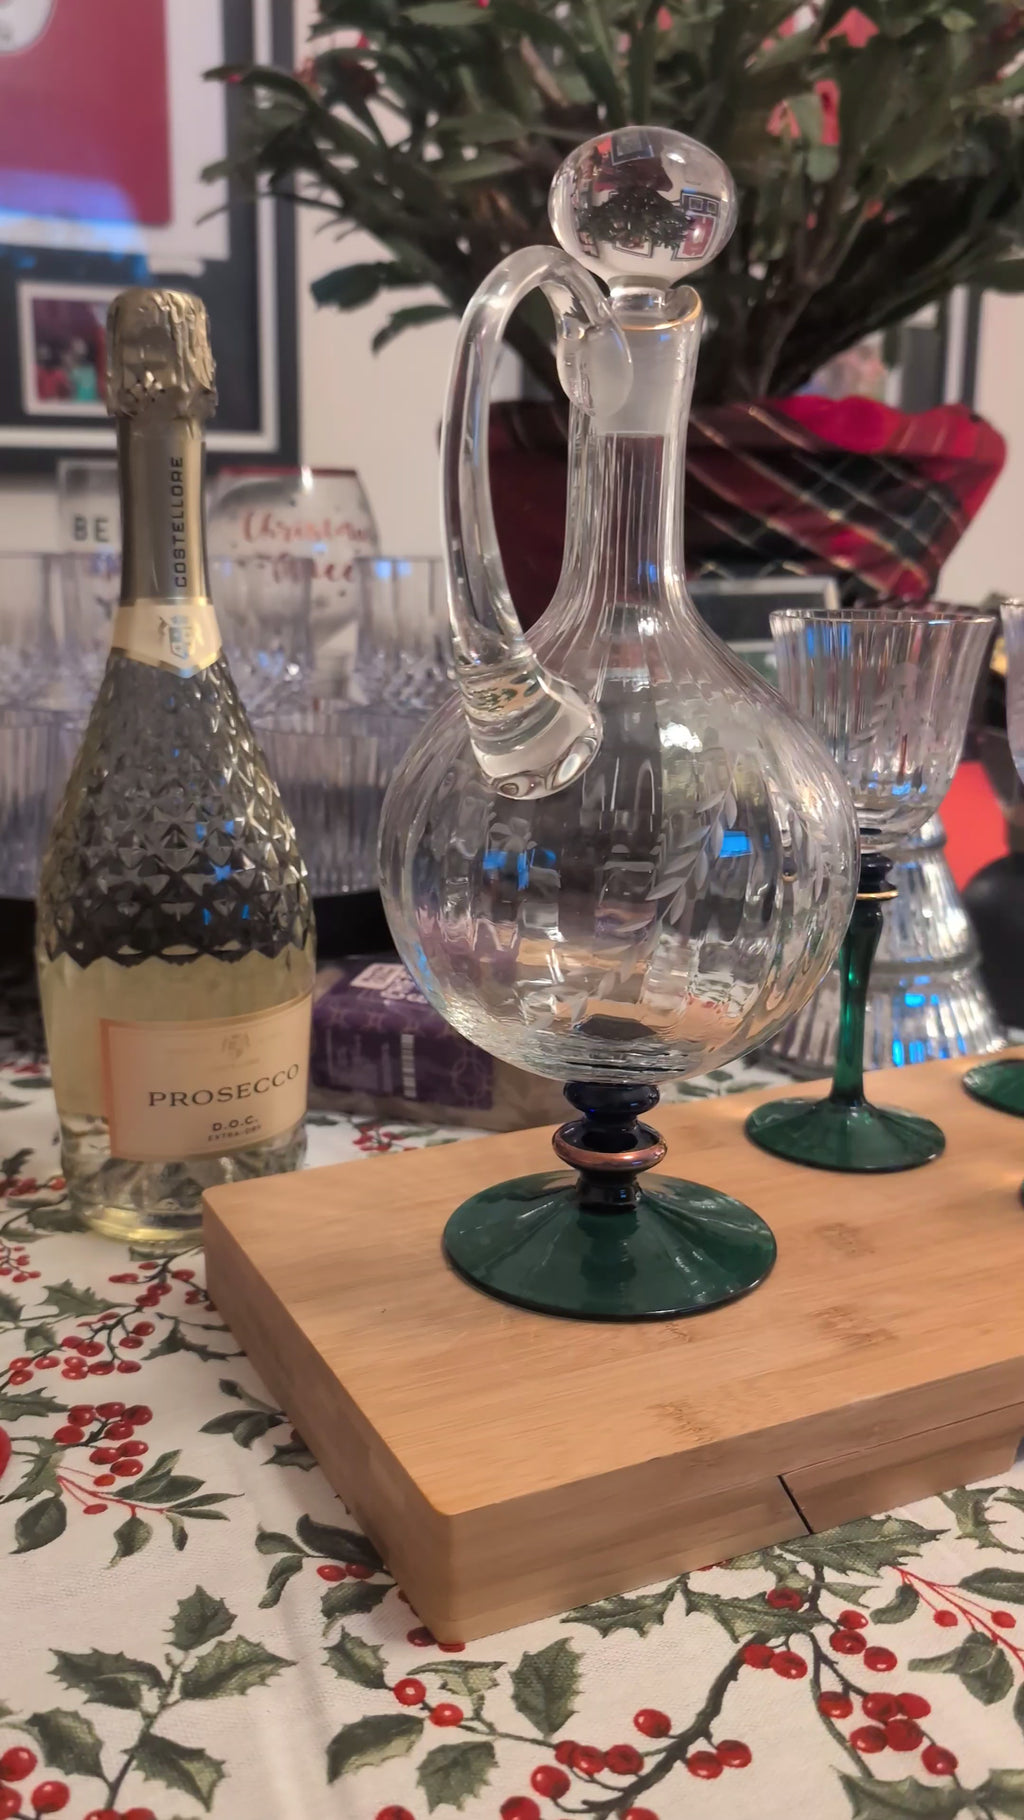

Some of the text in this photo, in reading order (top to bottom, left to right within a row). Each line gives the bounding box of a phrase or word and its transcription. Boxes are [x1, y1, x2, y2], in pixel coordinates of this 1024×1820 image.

[170, 456, 188, 588] COSTELLORE
[148, 1063, 299, 1107] PROSECCO
[212, 1115, 258, 1131] D.O.C.
